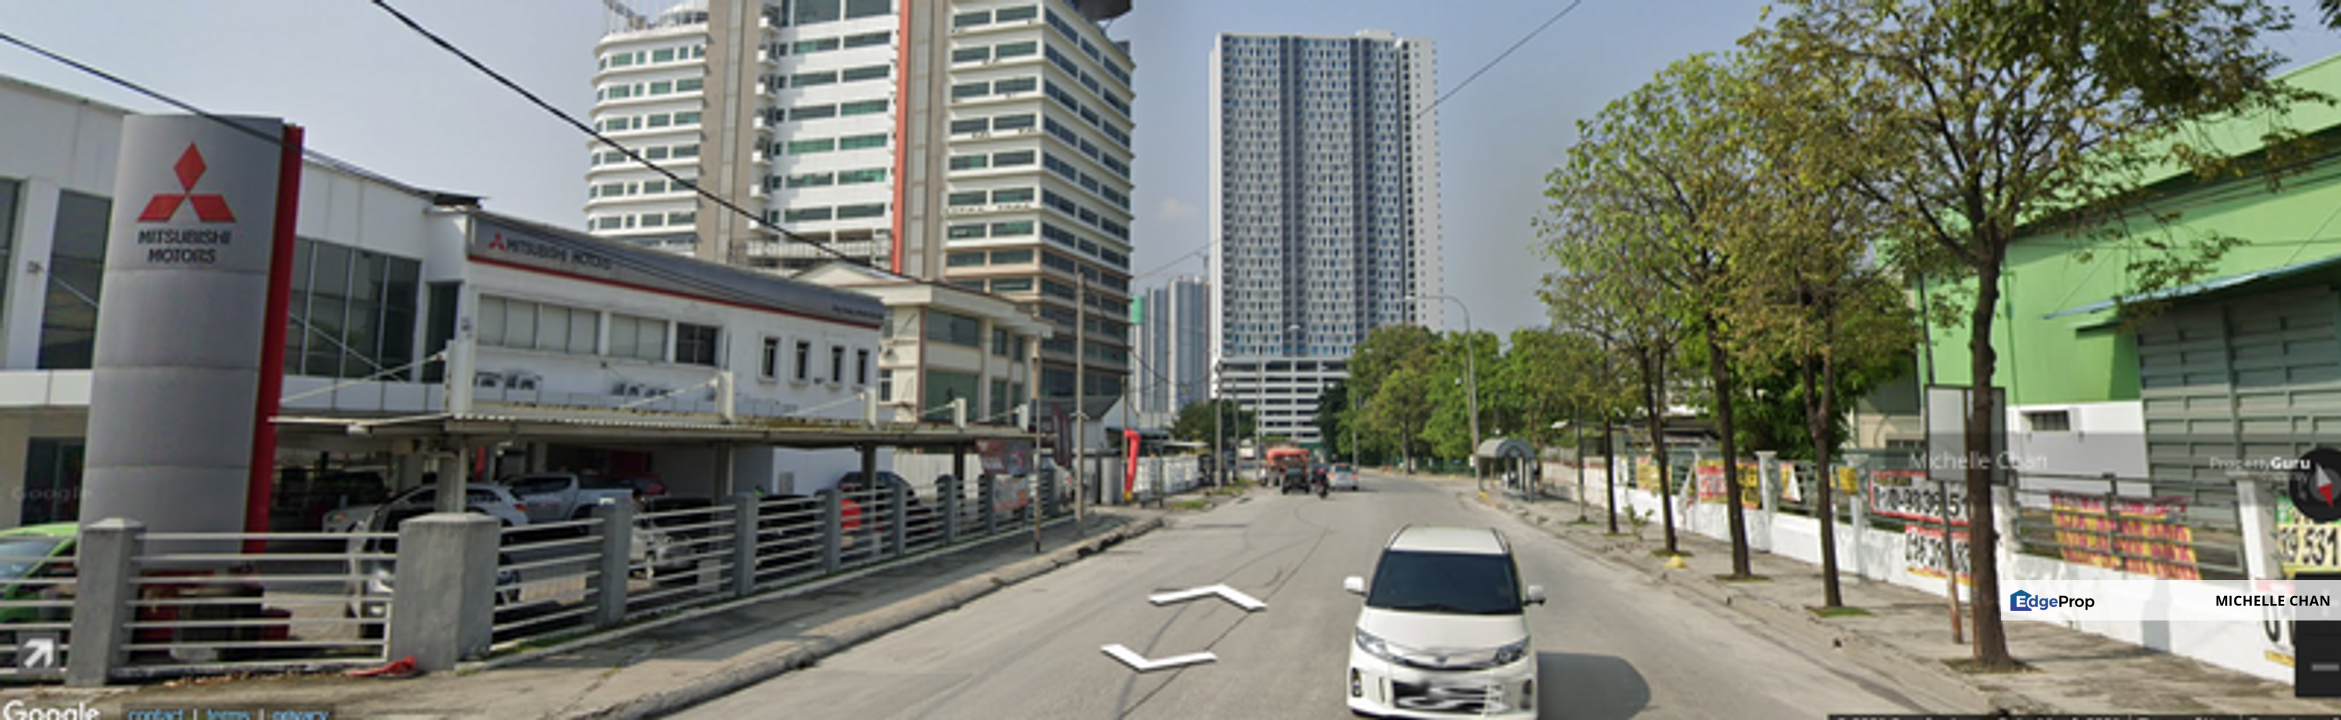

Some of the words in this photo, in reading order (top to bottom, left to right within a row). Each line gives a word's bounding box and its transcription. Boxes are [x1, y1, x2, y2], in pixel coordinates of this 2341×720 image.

[137, 229, 233, 244] MITSUBISHI
[147, 248, 216, 263] MOTORS
[506, 238, 567, 262] MITSUBISHI
